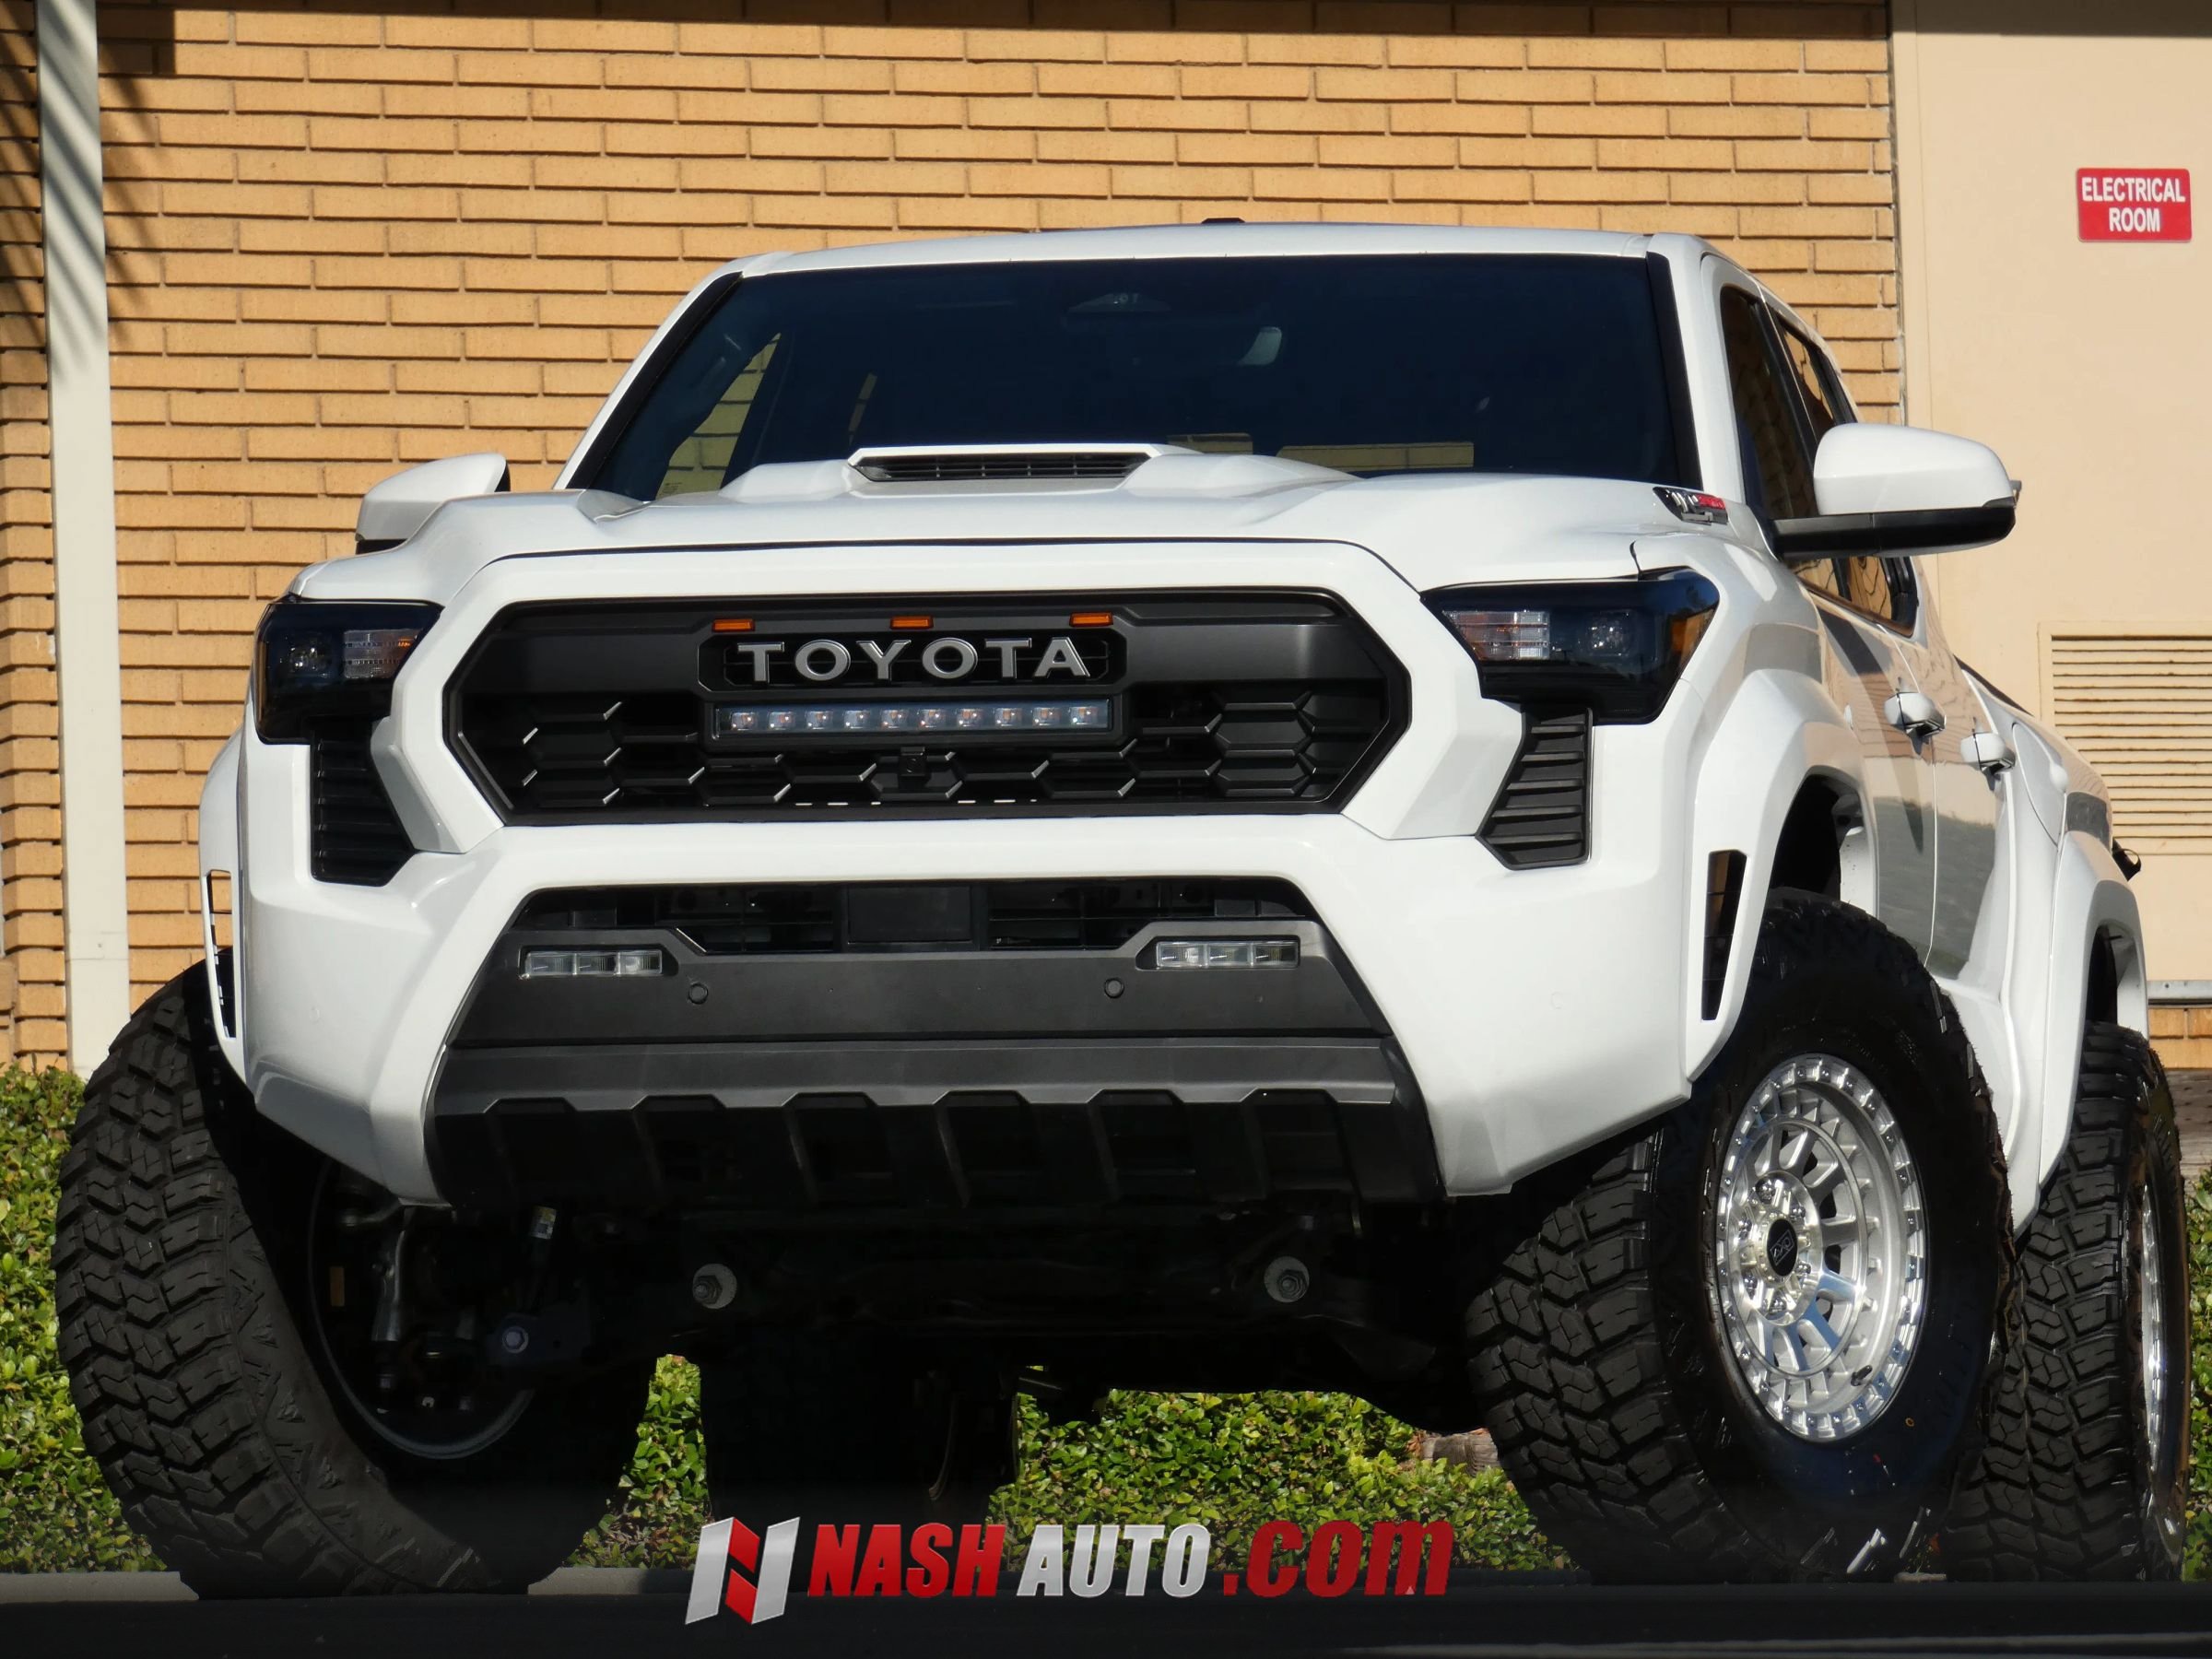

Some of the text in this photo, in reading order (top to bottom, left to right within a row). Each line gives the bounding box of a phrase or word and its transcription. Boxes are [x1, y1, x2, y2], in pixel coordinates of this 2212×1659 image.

[2081, 177, 2186, 203] ELECTRICAL
[2108, 207, 2160, 232] ROOM
[736, 636, 1091, 682] TOYOTA
